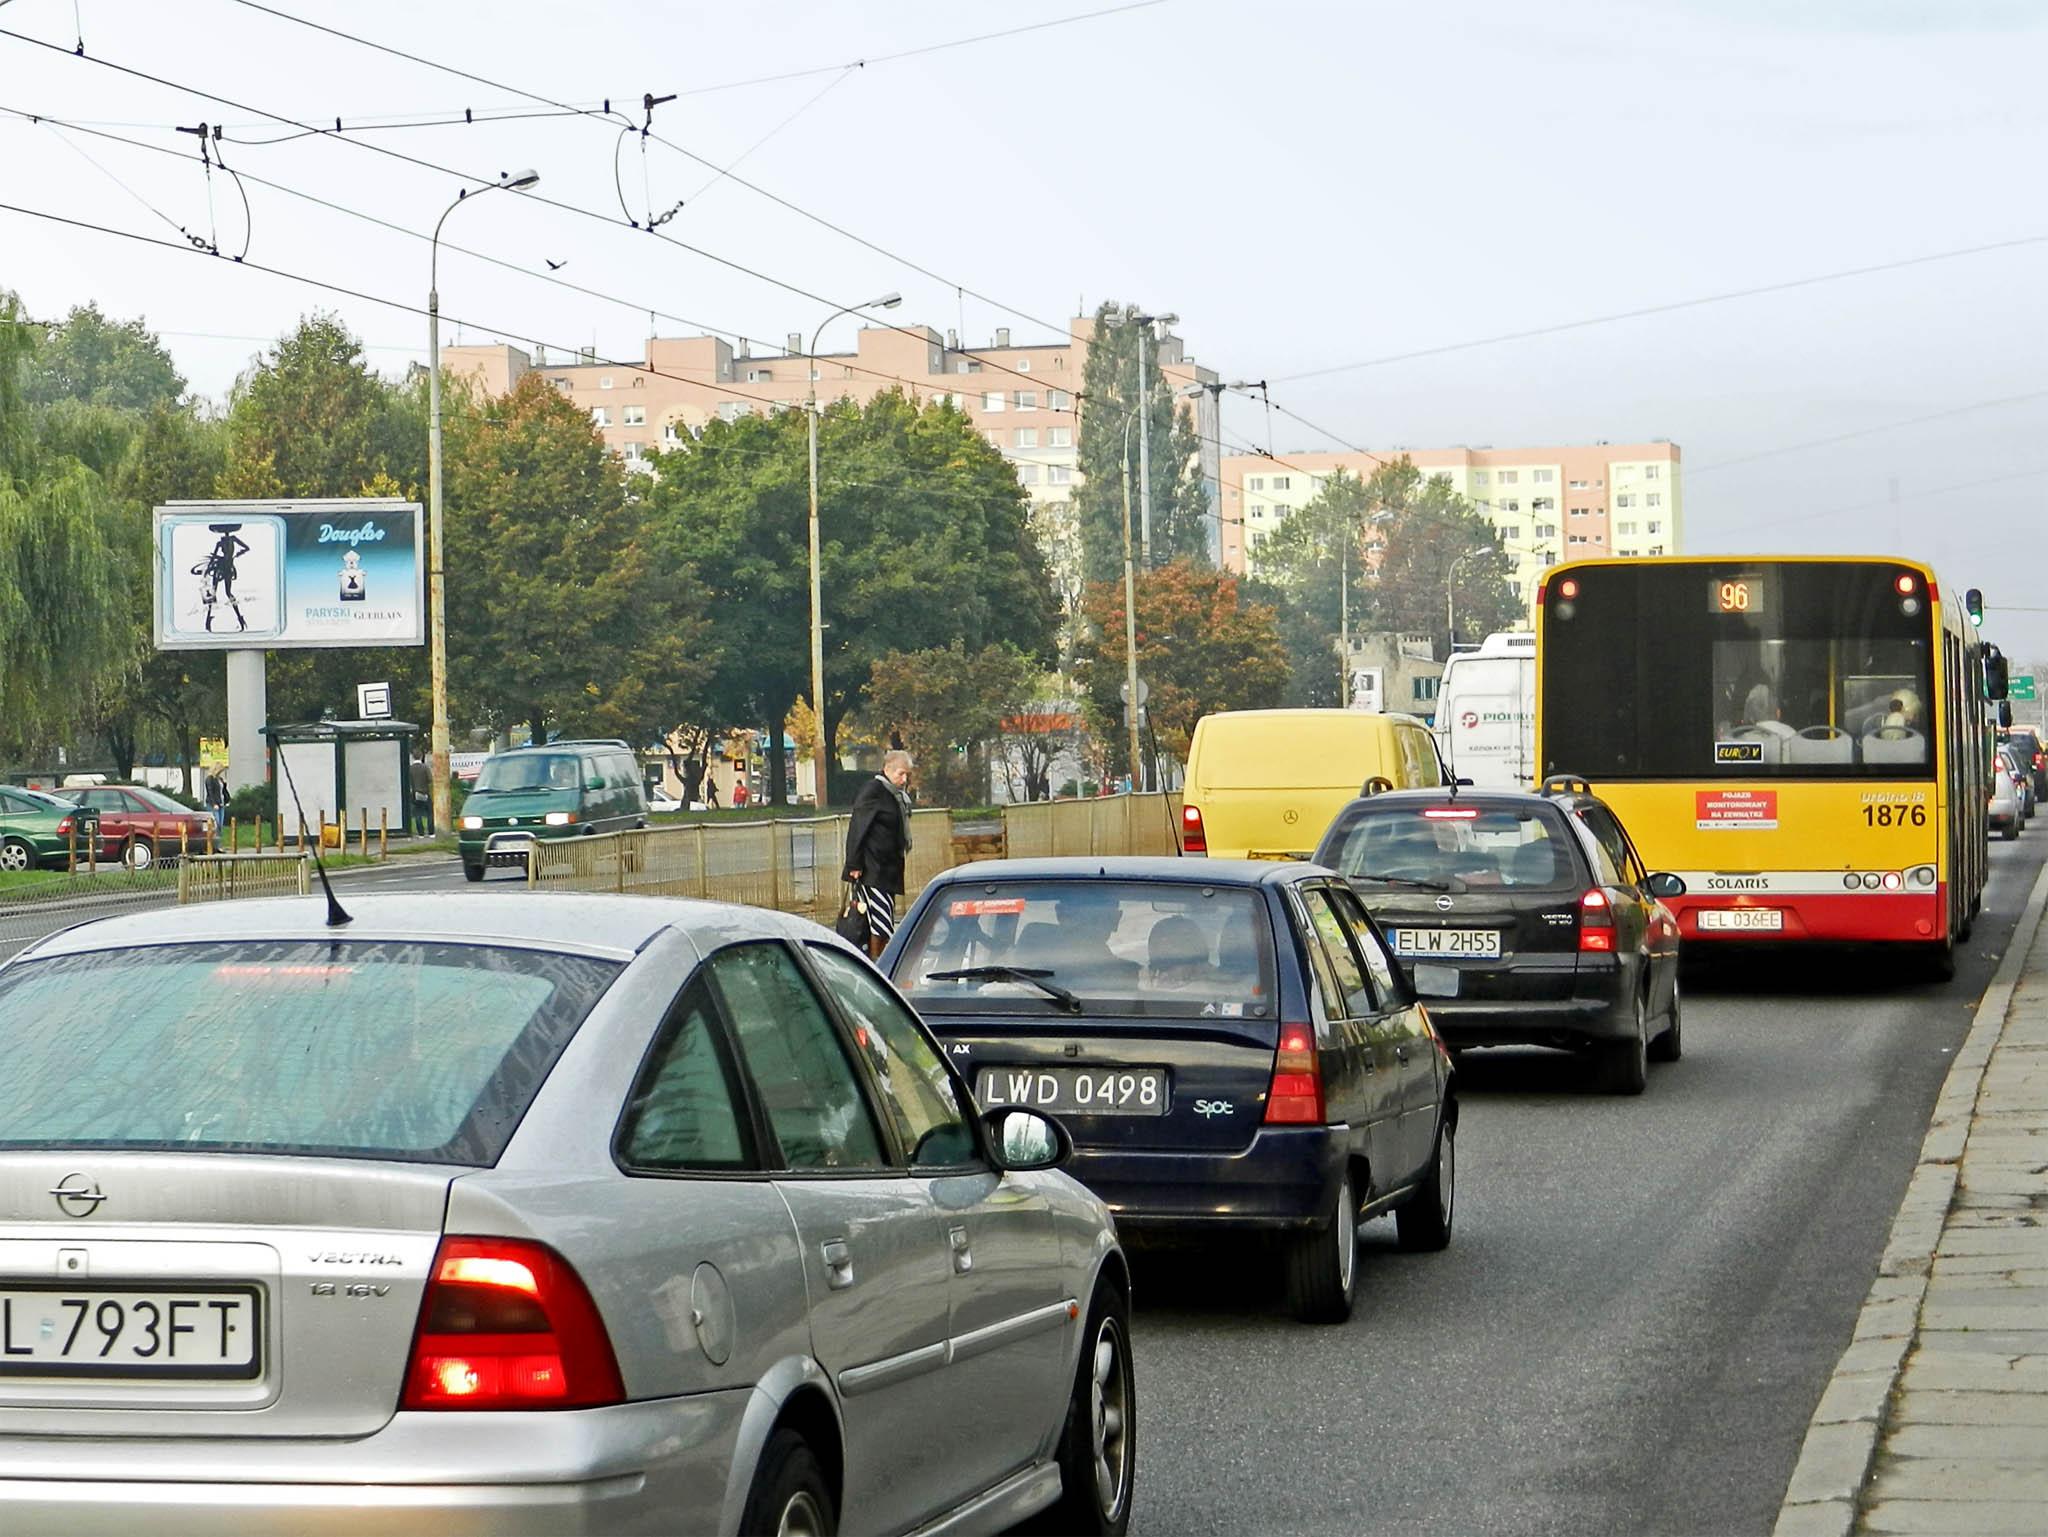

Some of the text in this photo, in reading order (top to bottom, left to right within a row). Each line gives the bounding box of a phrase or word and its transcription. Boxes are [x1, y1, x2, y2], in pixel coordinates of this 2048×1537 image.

[318, 521, 385, 547] Douglas
[1721, 583, 1748, 610] 96
[305, 607, 351, 618] PARYSKI
[1752, 747, 1760, 758] V
[1722, 791, 1752, 799] POJAZD
[1706, 801, 1767, 809] MONITOROWANY
[1863, 804, 1926, 827] 1876
[1707, 878, 1769, 889] SOLARIS
[1707, 912, 1779, 927] EL 036EE
[1400, 931, 1497, 951] ELW 2H55
[953, 1044, 970, 1054] AX
[986, 1073, 1157, 1105] LWD 0498
[1193, 1099, 1234, 1119] Spot
[307, 1251, 403, 1265] VECTRA
[61, 1299, 240, 1358] 793FT
